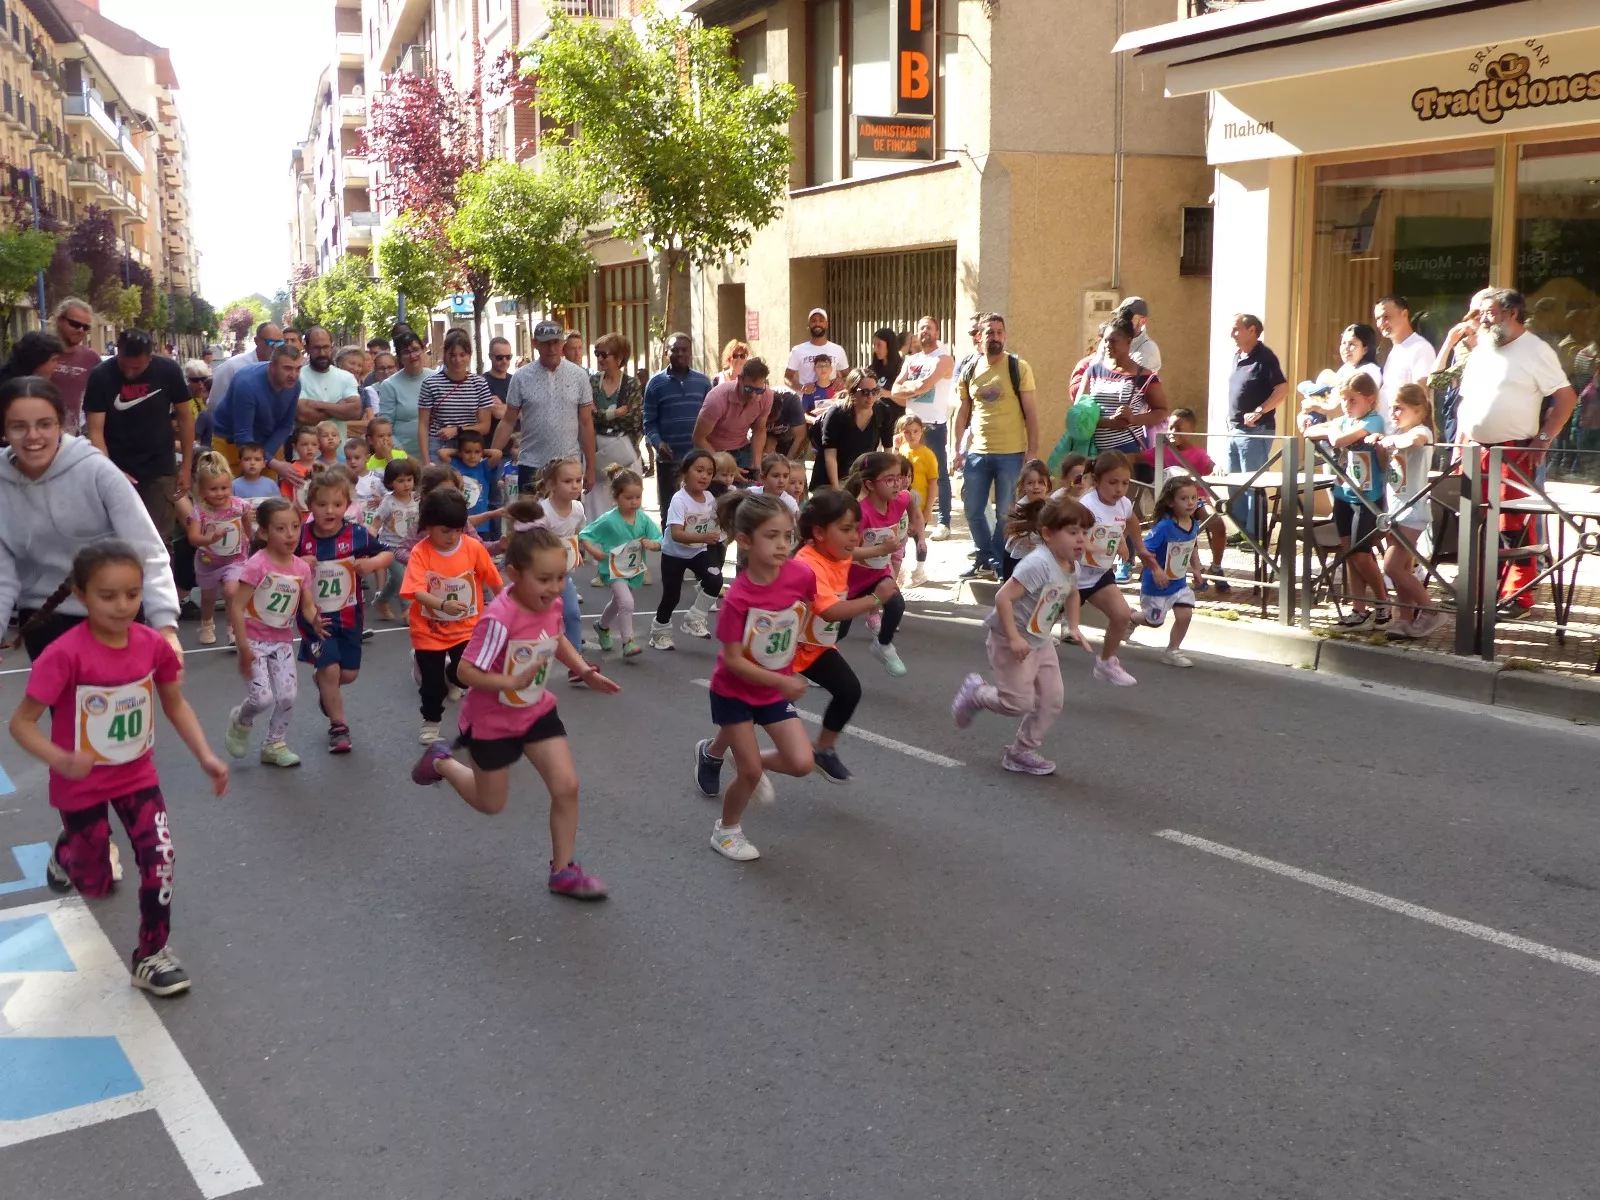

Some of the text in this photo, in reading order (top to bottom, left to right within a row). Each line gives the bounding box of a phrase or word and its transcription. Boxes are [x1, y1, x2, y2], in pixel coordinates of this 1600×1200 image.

[859, 124, 931, 139] ADMINISTRACION
[1224, 120, 1275, 139] Mahou
[873, 139, 917, 153] DE FINCAS
[629, 553, 637, 567] 2
[317, 578, 342, 598] 24
[266, 592, 292, 613] 27
[765, 627, 792, 655] 30
[107, 708, 142, 742] 40
[154, 811, 175, 906] adidas
